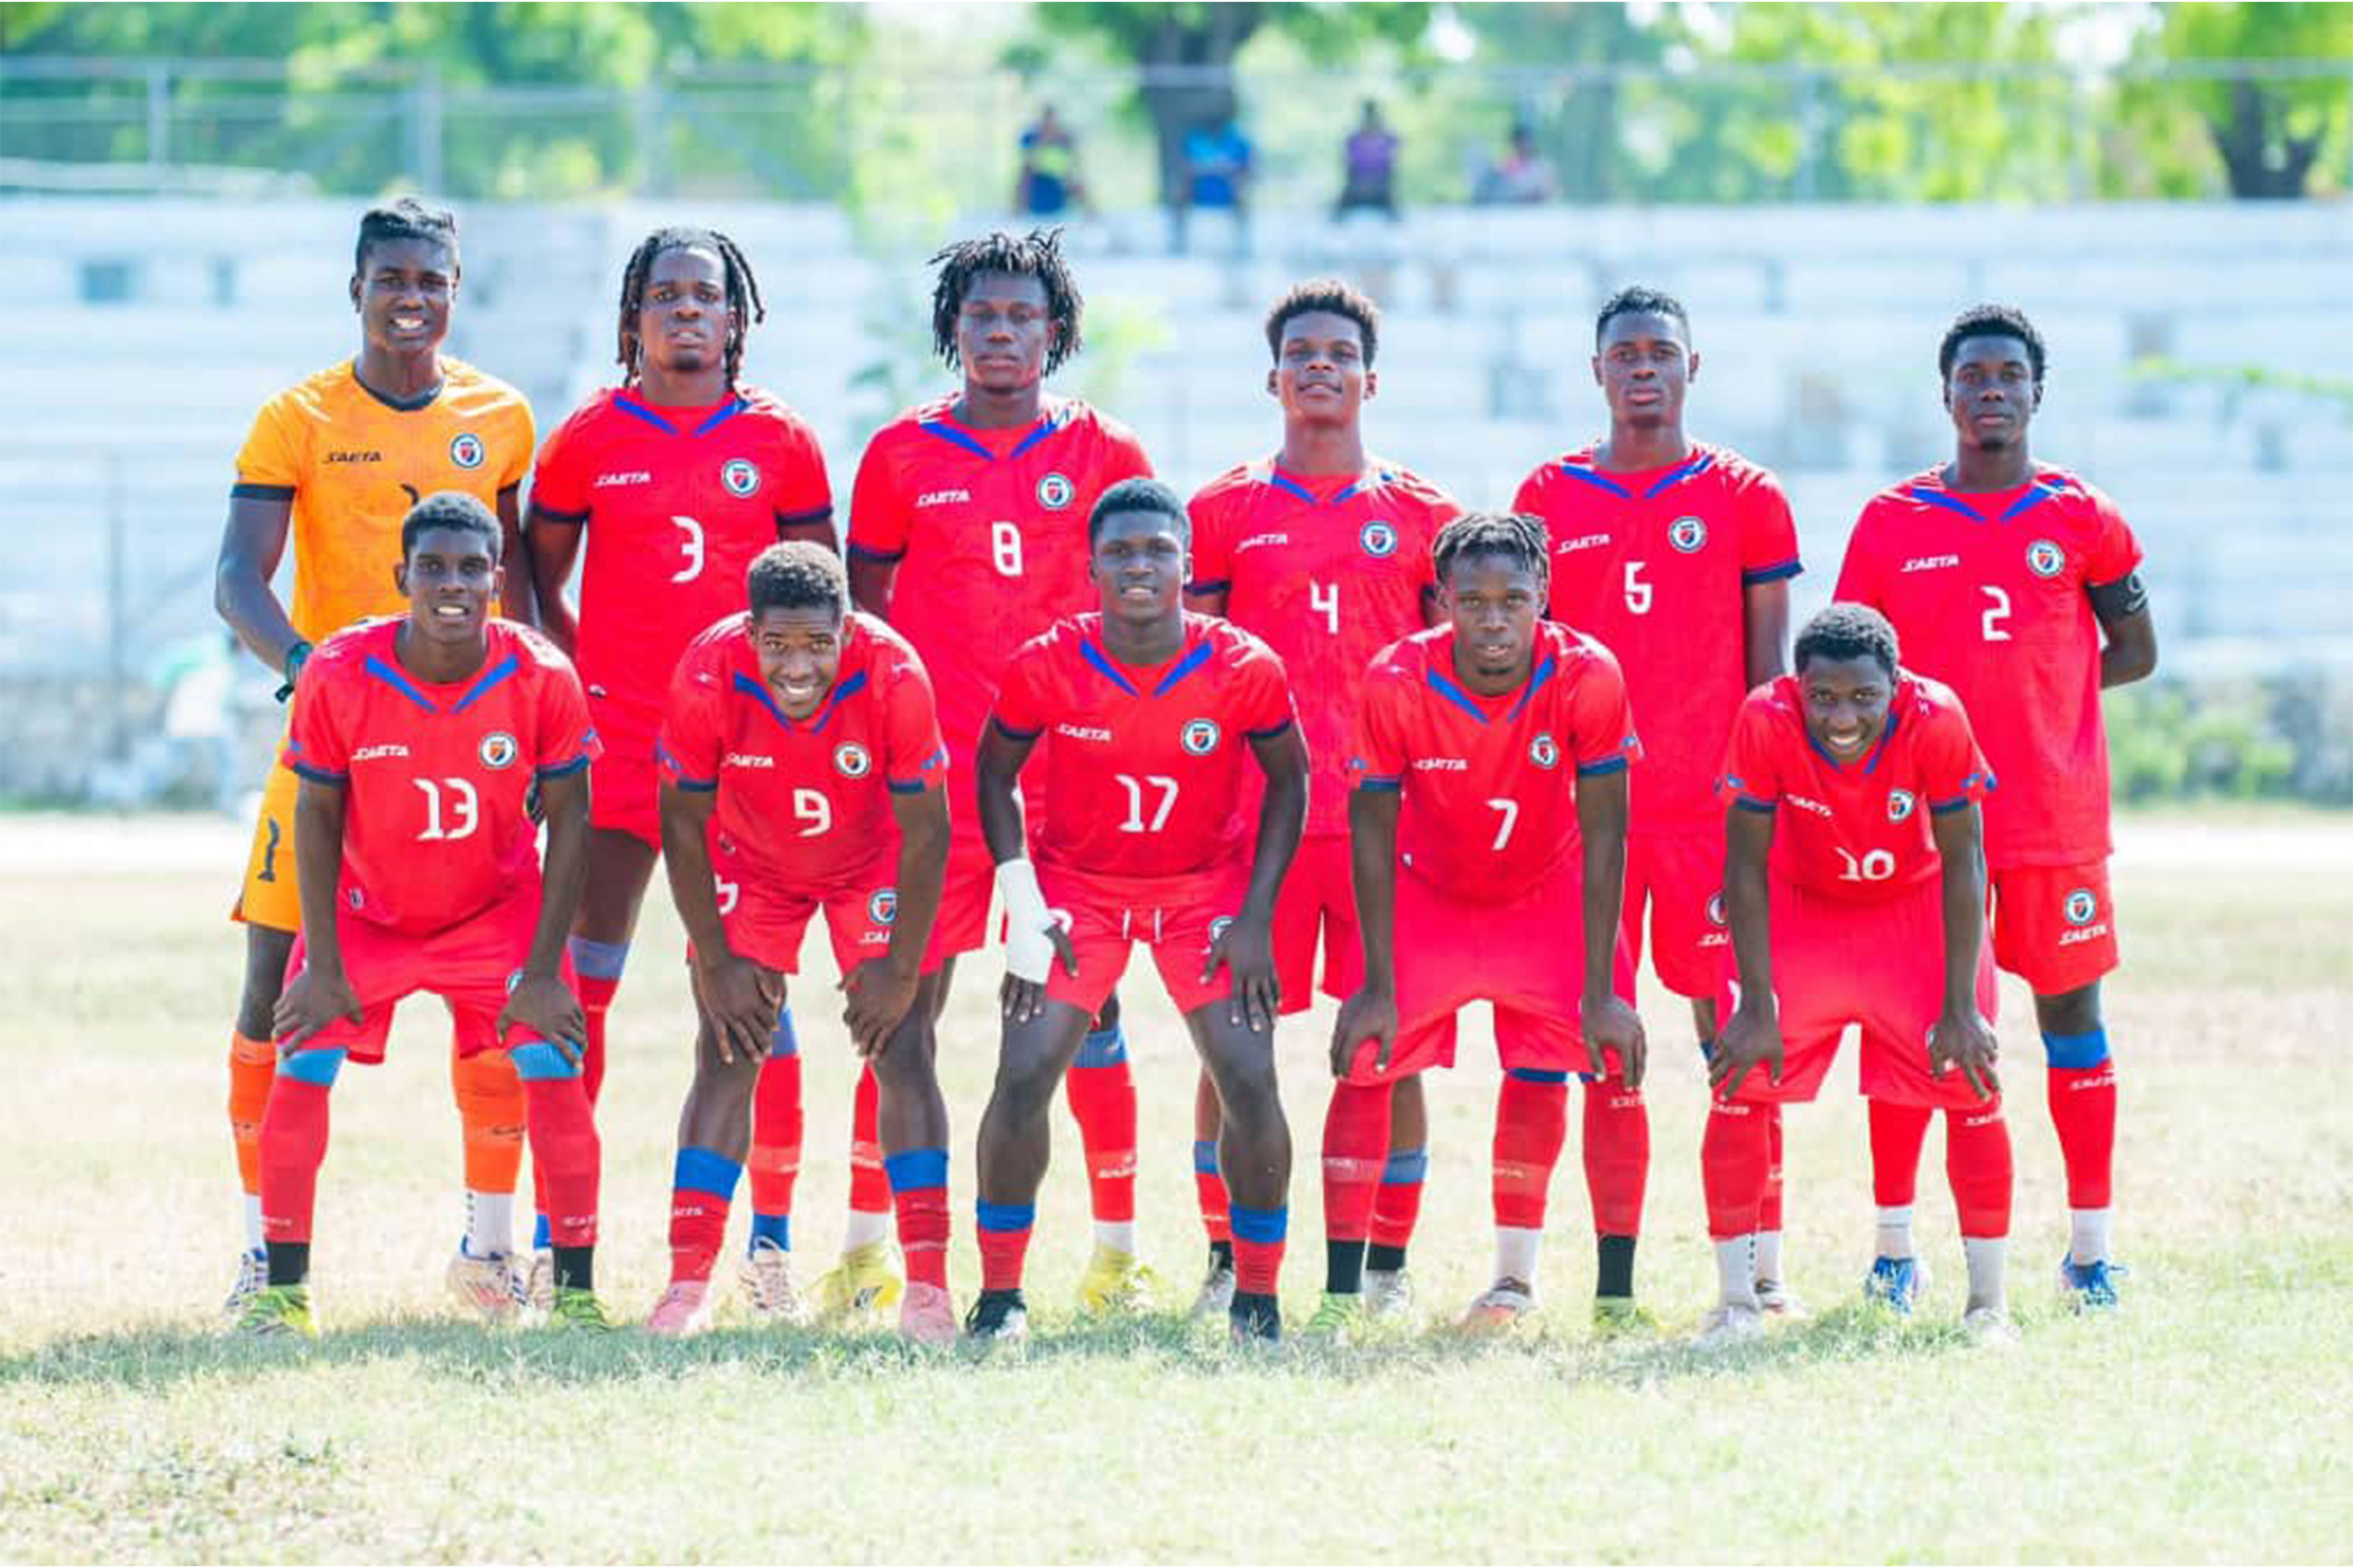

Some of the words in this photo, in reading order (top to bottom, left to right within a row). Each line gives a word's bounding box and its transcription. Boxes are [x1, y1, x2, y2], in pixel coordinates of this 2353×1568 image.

[324, 451, 382, 464] SAETA
[595, 471, 651, 487] SAETA
[916, 489, 971, 507] SAETA
[670, 516, 705, 583] 3
[992, 521, 1023, 577] 8
[1556, 534, 1610, 554] SAETA
[1900, 554, 1959, 573] SAETA
[1310, 580, 1339, 635] 4
[1624, 561, 1653, 614] 5
[1981, 585, 2011, 641] 2
[351, 744, 409, 761] SAETA
[1057, 723, 1113, 742] SAETA
[414, 777, 478, 840] 13
[793, 788, 831, 837] 9
[1115, 774, 1180, 833] 17
[1486, 798, 1519, 851] 7
[258, 818, 281, 883] 1
[1834, 846, 1896, 882] 10
[2058, 924, 2108, 945] SAETA
